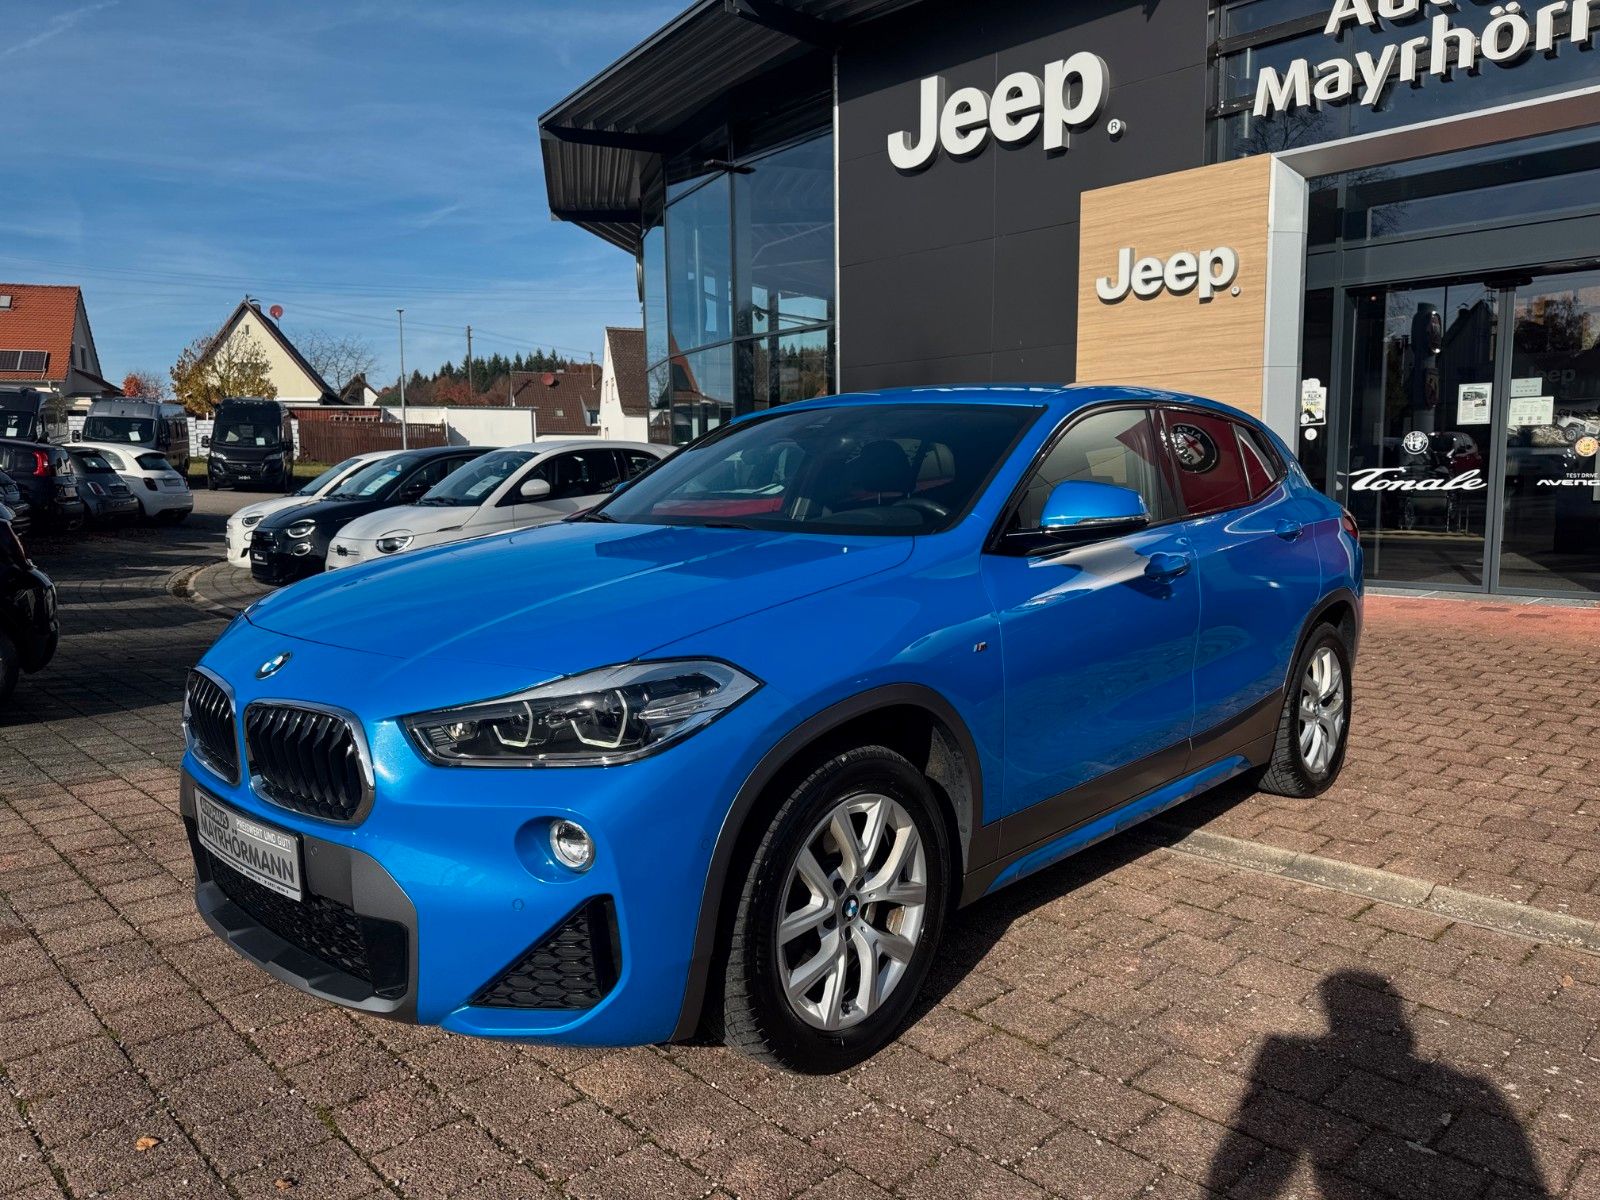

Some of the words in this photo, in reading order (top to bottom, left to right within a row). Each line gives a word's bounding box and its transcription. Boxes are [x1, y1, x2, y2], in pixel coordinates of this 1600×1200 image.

[1324, 0, 1457, 35] Au
[887, 51, 1108, 169] Jeep
[1096, 246, 1238, 303] Jeep
[1348, 466, 1487, 491] Tonale
[200, 812, 295, 884] MAYRHÖRMANN
